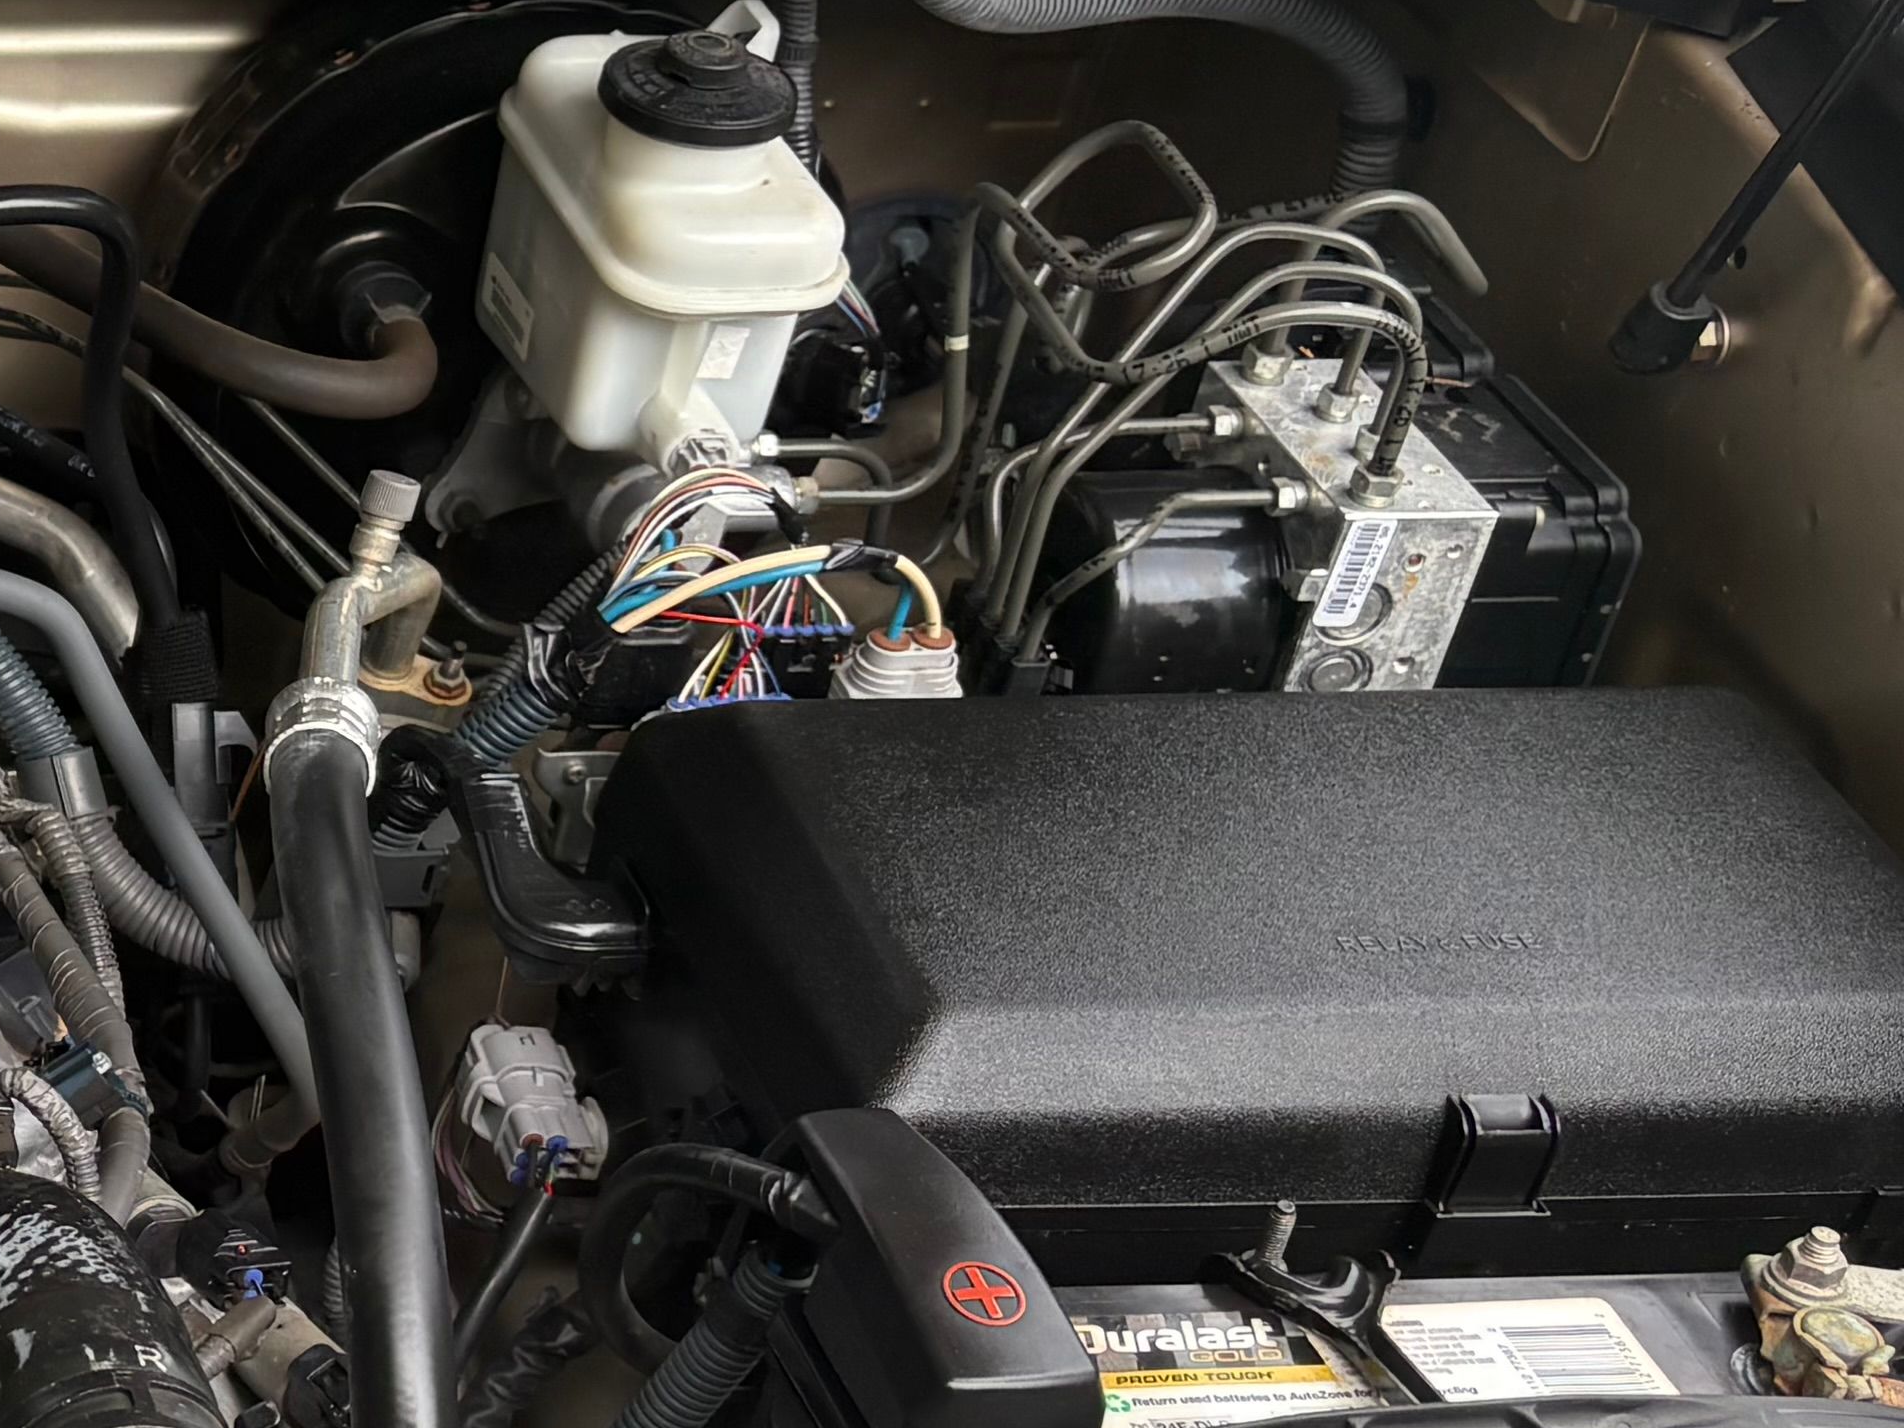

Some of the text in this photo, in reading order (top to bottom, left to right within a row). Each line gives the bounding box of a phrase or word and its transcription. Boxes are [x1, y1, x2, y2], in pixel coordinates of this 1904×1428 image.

[1075, 1317, 1278, 1355] Duralast
[1190, 1348, 1283, 1363] GOLD
[1116, 1370, 1273, 1386] PROVEN TOUGH
[1131, 1397, 1176, 1408] Return
[1180, 1394, 1211, 1404] used
[1214, 1392, 1270, 1403] batteries
[1273, 1392, 1287, 1401] to
[1290, 1390, 1352, 1401] AutoZone
